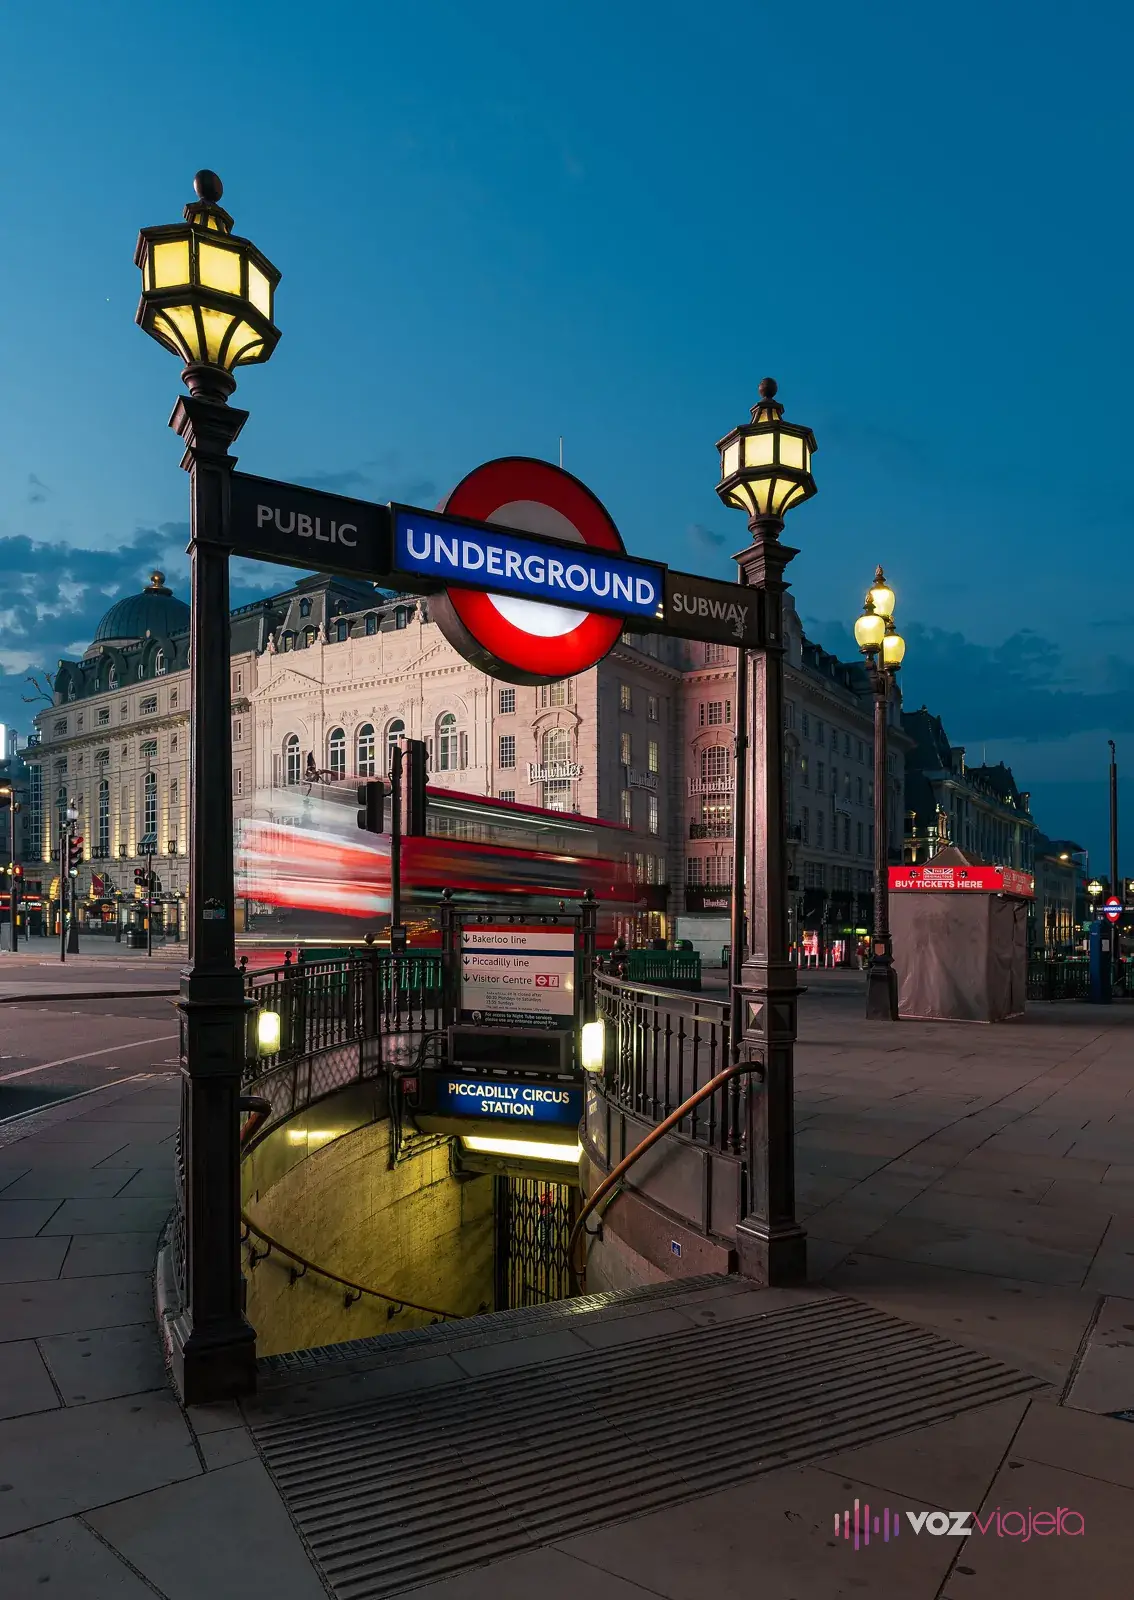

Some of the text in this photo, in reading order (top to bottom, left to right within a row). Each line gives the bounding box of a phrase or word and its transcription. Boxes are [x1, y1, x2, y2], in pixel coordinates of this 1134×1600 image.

[256, 504, 358, 548] PUBLIC
[406, 528, 655, 606] UNDERGROUND
[672, 592, 749, 623] SUBWAY
[895, 880, 915, 888] BUY
[916, 880, 955, 888] TICKETS
[472, 934, 527, 944] Bakerloo line
[472, 956, 530, 967] Piccadilly line
[472, 974, 500, 983] Visitor
[502, 976, 532, 984] Centre
[448, 1082, 519, 1100] PICCADILLY
[522, 1089, 570, 1104] CIRCUS
[481, 1100, 534, 1116] STATION
